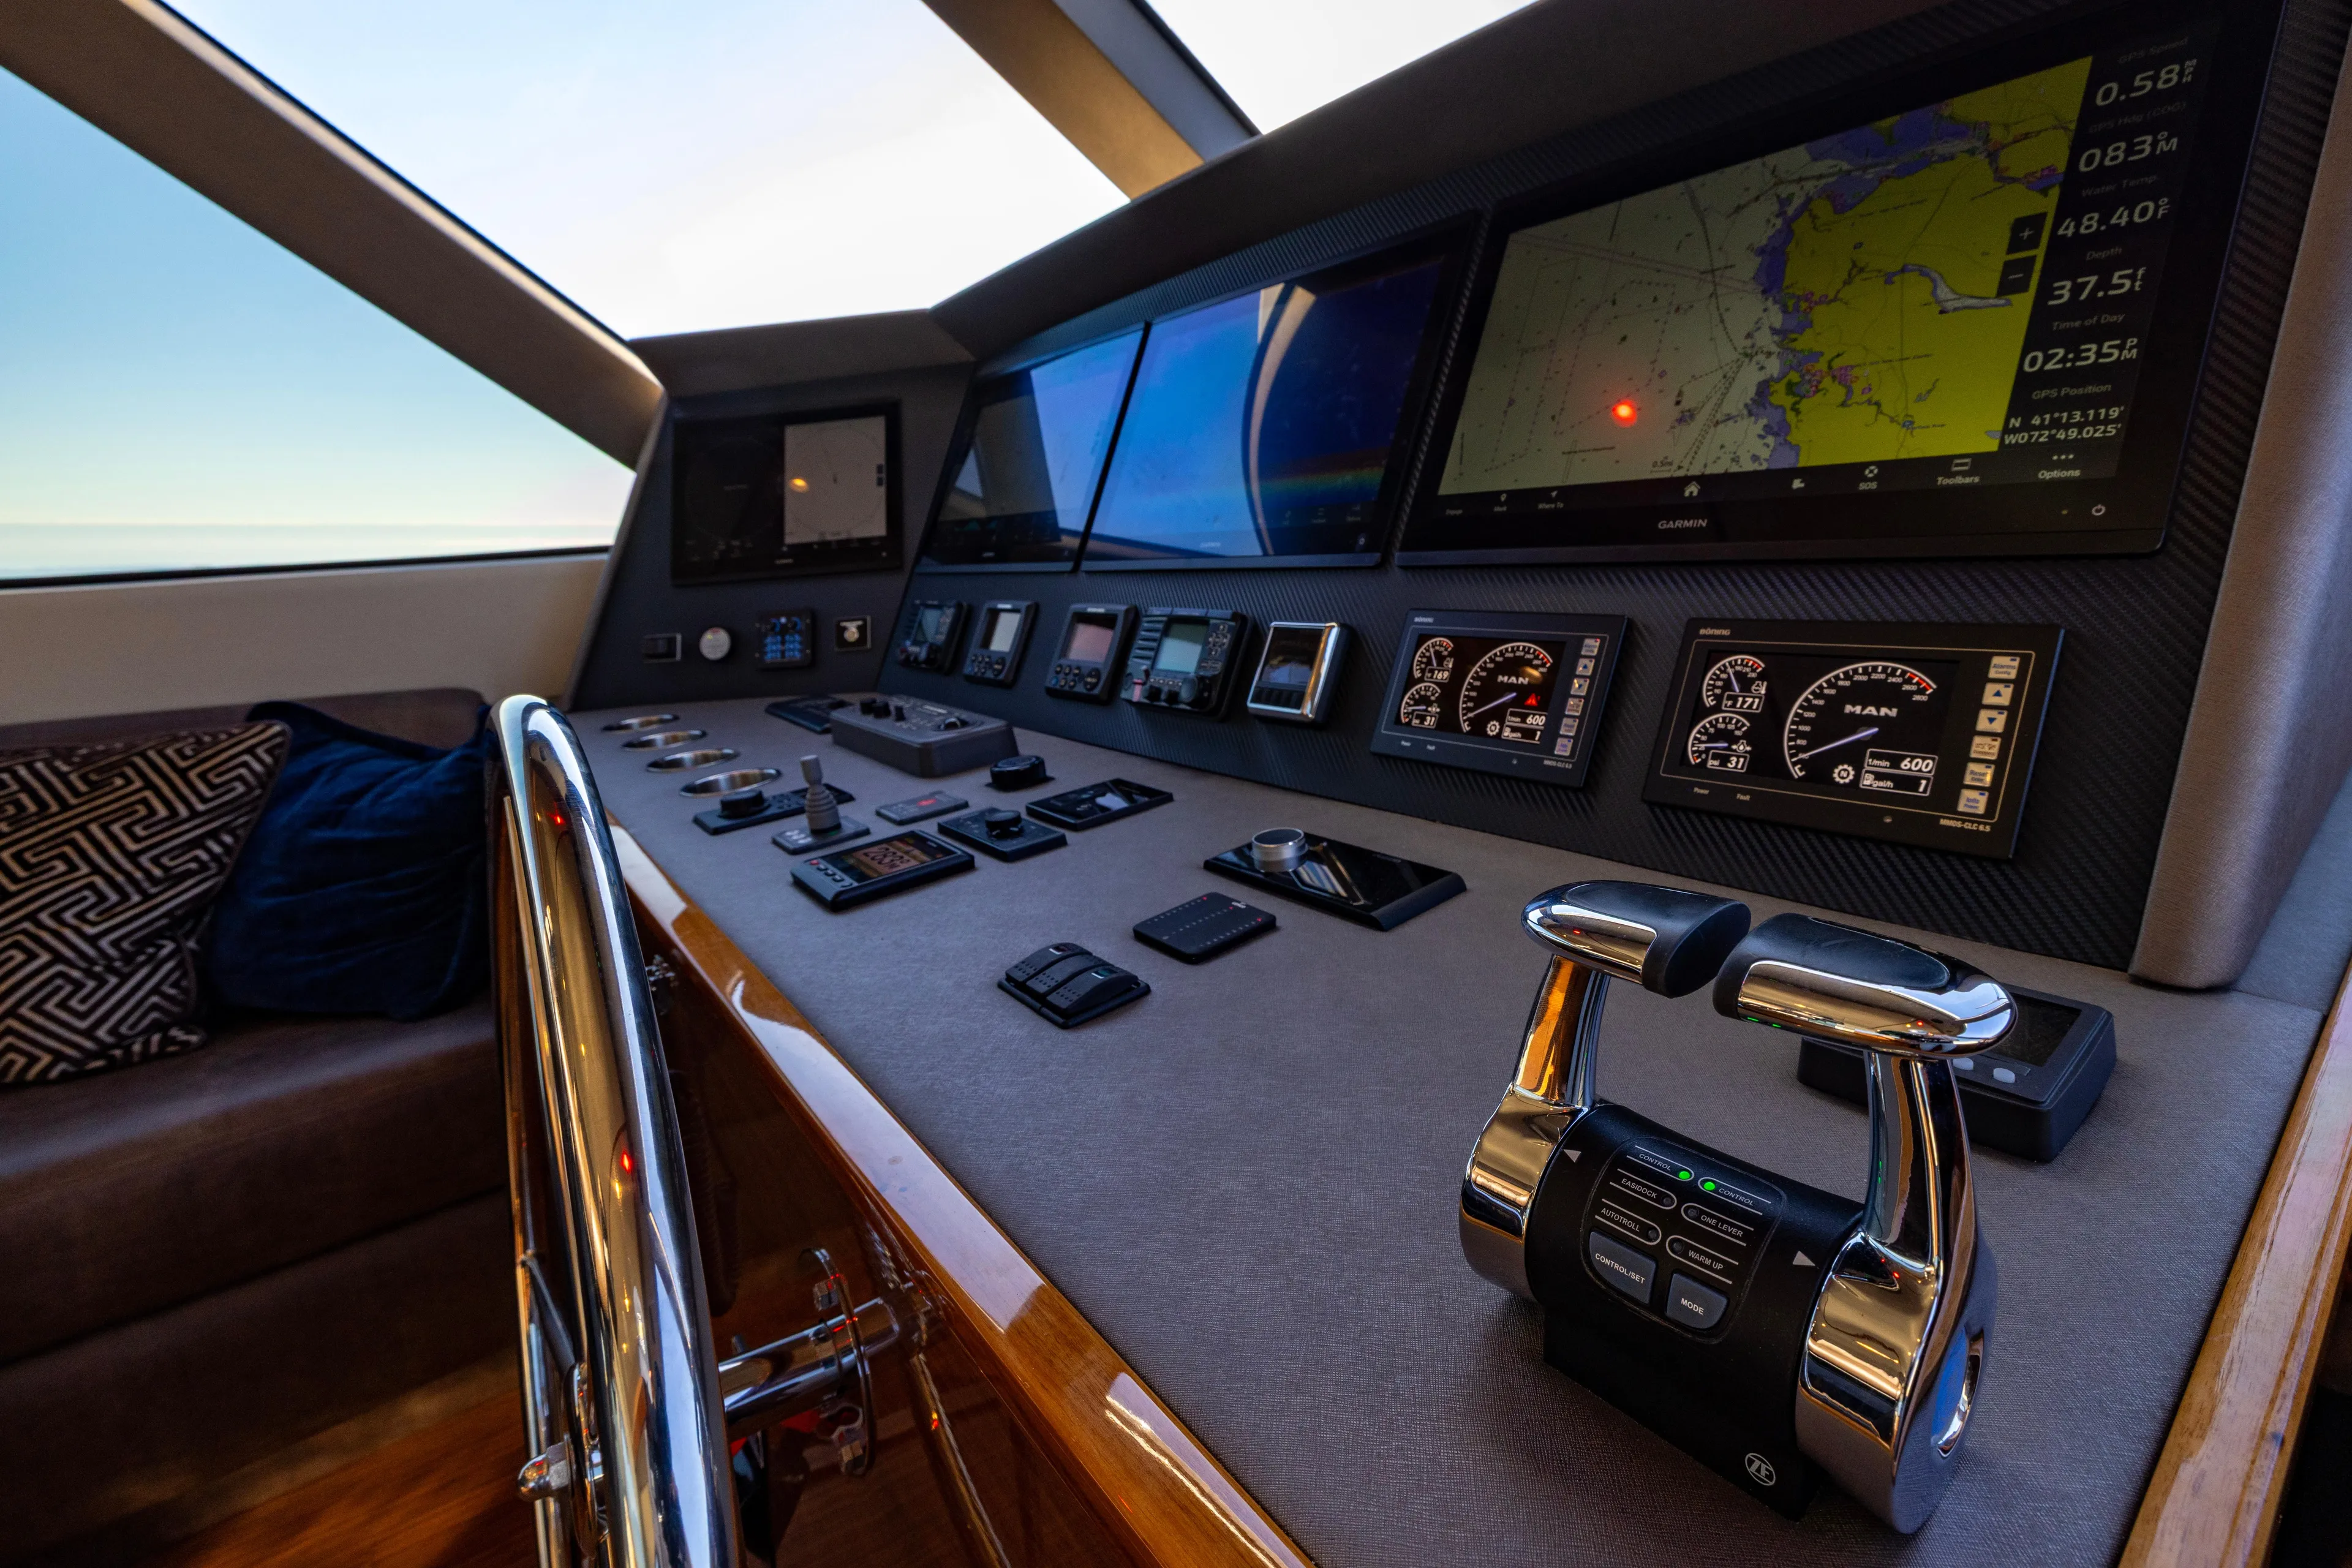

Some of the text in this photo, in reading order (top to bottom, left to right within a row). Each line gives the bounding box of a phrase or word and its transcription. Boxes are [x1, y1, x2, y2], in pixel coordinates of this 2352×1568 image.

[2095, 64, 2180, 107] 0.58
[2078, 135, 2153, 173] 083
[2057, 201, 2155, 238] 48.40
[2086, 247, 2122, 261] Depth
[2048, 270, 2133, 306] 37.5
[2052, 313, 2125, 331] Time of Day
[2023, 341, 2120, 372] 02:35
[2032, 383, 2112, 400] GPS Position
[2008, 417, 2021, 429] N
[1936, 475, 1980, 486] Toolbars
[2038, 468, 2081, 480] Options
[1858, 481, 1878, 491] SOS
[1657, 518, 1708, 529] GARMIN
[1433, 669, 1449, 680] 169
[1497, 674, 1529, 685] MAN
[1736, 696, 1760, 709] 171
[1844, 704, 1898, 717] MAN
[1423, 715, 1436, 726] 31
[1526, 714, 1546, 726] 600
[1727, 756, 1745, 769] 31
[1868, 757, 1934, 772] 1/min 600
[1918, 778, 1928, 793] 1
[1638, 1152, 1671, 1171] CONTROL
[1621, 1177, 1657, 1199] EASIDOCK
[1718, 1187, 1754, 1207] CONTROL
[1600, 1207, 1640, 1232] AUTOTROLL
[1700, 1214, 1743, 1238] ONE LEVER
[1595, 1252, 1645, 1284] CONTROL/SET
[1688, 1250, 1724, 1270] WARM UP
[1680, 1297, 1704, 1316] MODE
[1747, 1457, 1773, 1477] ZF
